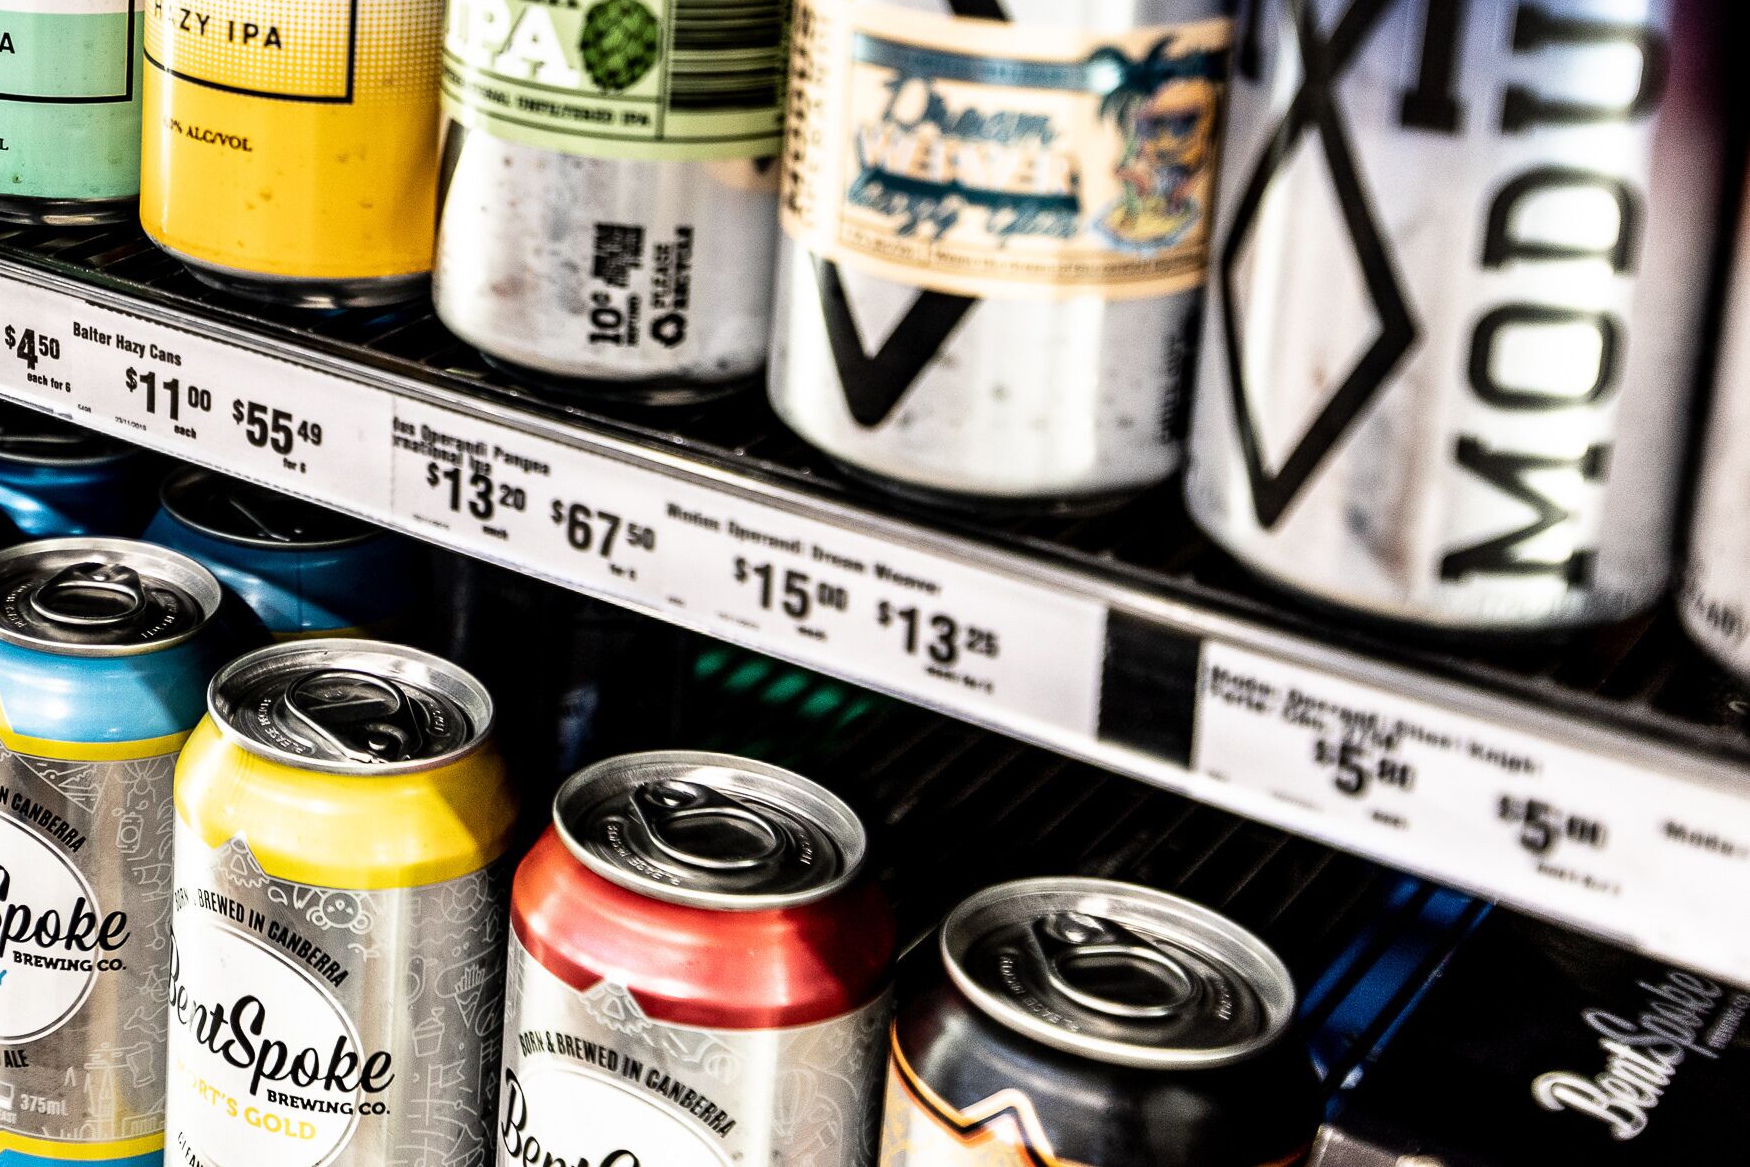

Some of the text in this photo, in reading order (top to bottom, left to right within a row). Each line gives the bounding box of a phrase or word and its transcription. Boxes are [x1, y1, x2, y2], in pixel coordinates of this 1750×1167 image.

[227, 17, 283, 51] IPA
[4, 324, 61, 371] $450
[72, 320, 182, 367] Balter Hazy Cans
[27, 371, 49, 387] each
[50, 376, 64, 391] for
[65, 381, 72, 393] 6
[124, 365, 323, 457] $1100 $5549
[173, 423, 296, 470] each for
[421, 423, 551, 476] Operandi Pangea
[469, 453, 492, 477] Ipa
[426, 461, 526, 522] $1320
[10, 793, 87, 854] CANBERRA
[12, 949, 128, 974] BREWING CO.
[197, 888, 351, 989] BREWED IN CANBERRA
[168, 922, 397, 1097] BentSpoke
[3, 1046, 30, 1069] ALE
[1530, 969, 1725, 1142] BentSpoke
[19, 1092, 70, 1119] 375mL
[266, 1087, 392, 1117] BREWING CO.
[519, 1030, 738, 1140] BORN & BREWED IN CANBERRA
[243, 1105, 317, 1141] GOLD
